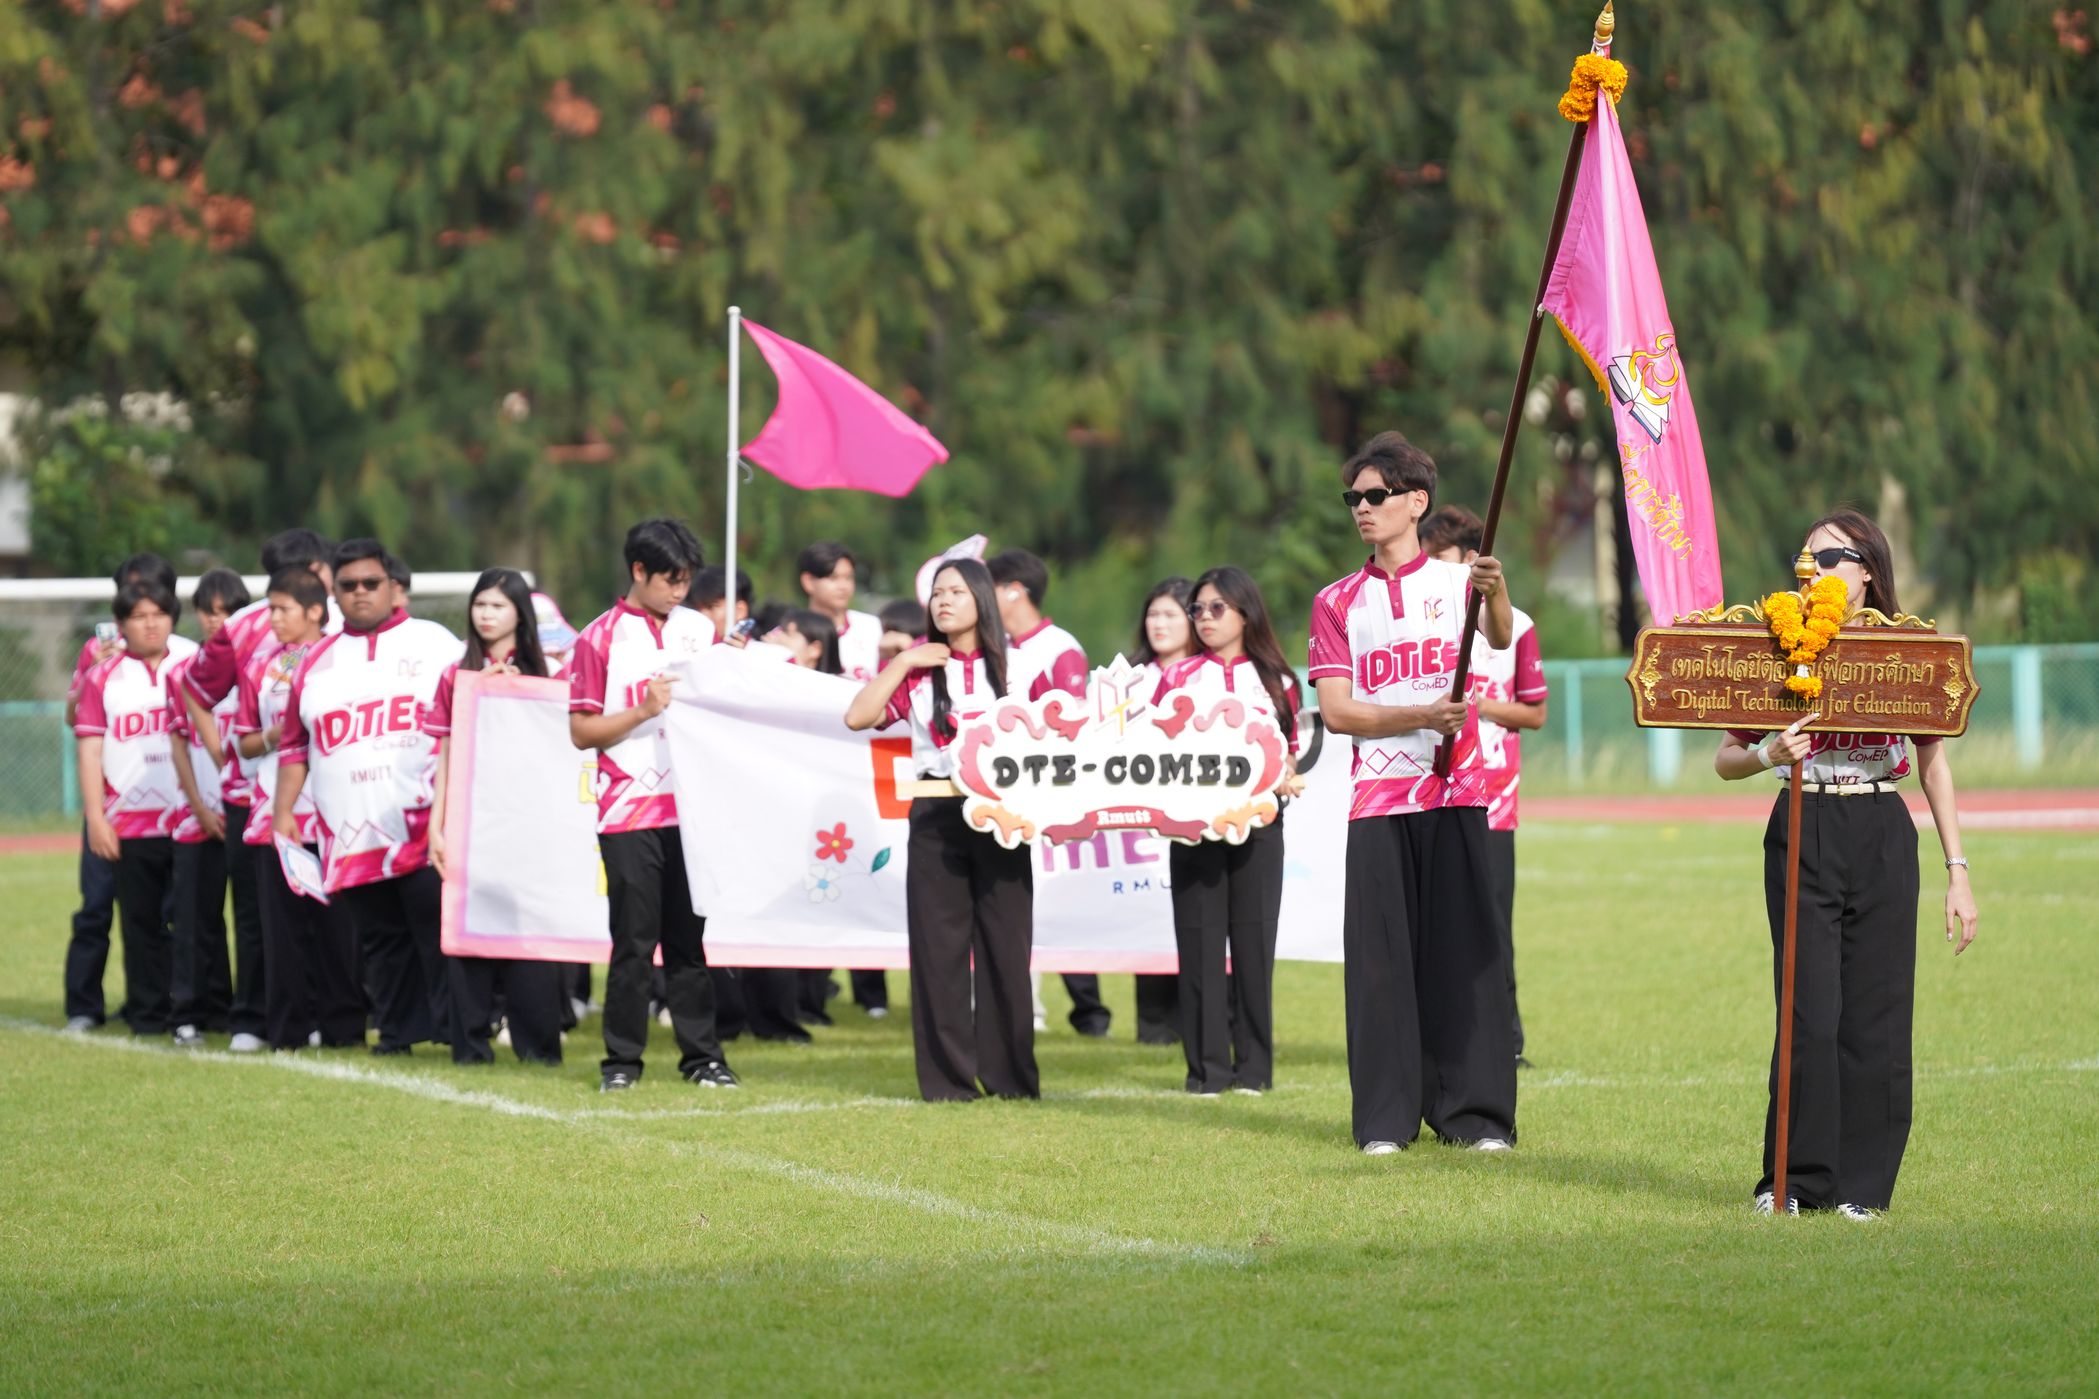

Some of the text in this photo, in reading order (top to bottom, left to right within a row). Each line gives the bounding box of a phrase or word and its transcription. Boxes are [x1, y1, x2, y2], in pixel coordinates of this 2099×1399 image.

[1367, 635, 1446, 693] DTE
[1671, 686, 1932, 721] Digital Technology for Education
[992, 753, 1252, 787] DTE-COMED
[1096, 809, 1151, 826] Rmutt
